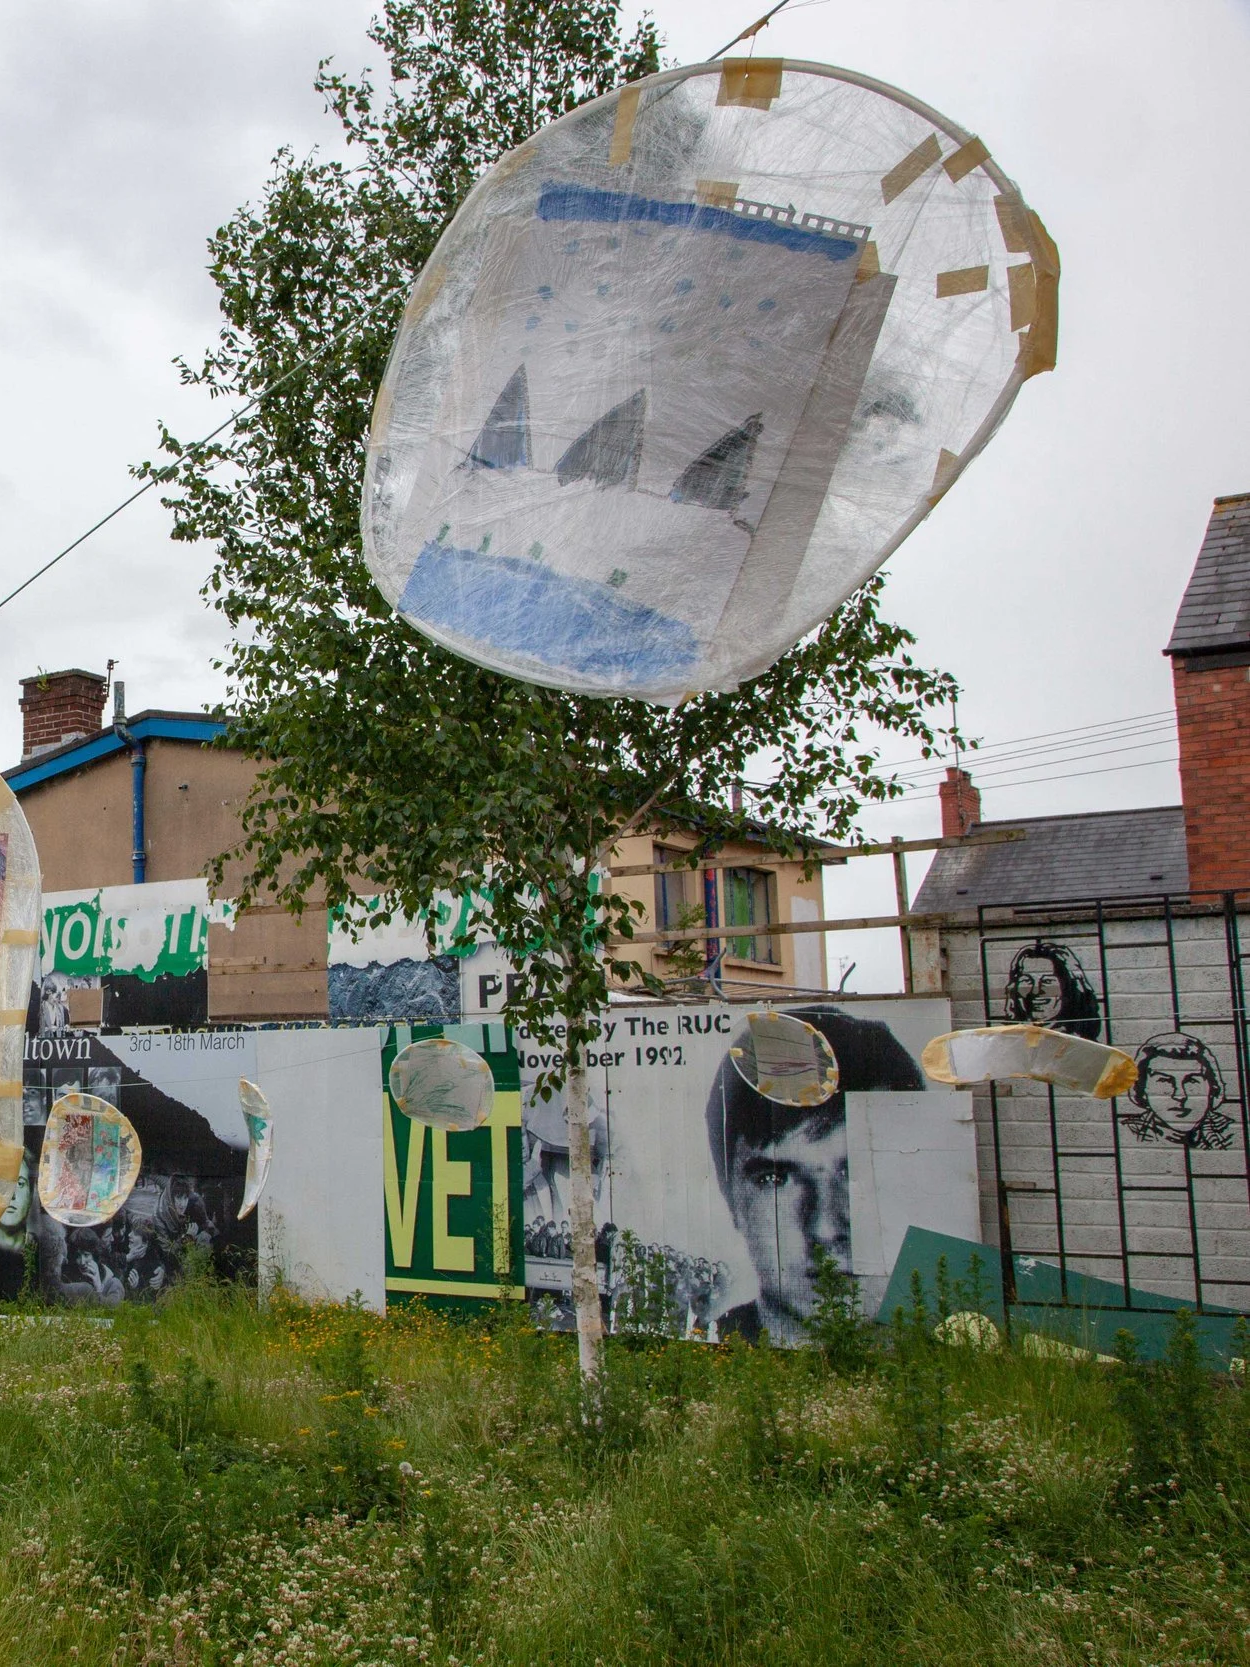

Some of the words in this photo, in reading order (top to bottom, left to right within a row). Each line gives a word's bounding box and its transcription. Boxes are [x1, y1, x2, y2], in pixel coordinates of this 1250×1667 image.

[589, 1018, 617, 1042] By
[624, 1016, 669, 1036] The
[678, 1014, 731, 1035] RUC
[129, 1035, 151, 1052] 3rd
[167, 1034, 195, 1051] 18th
[200, 1033, 245, 1050] March
[518, 1048, 624, 1068] Noveber
